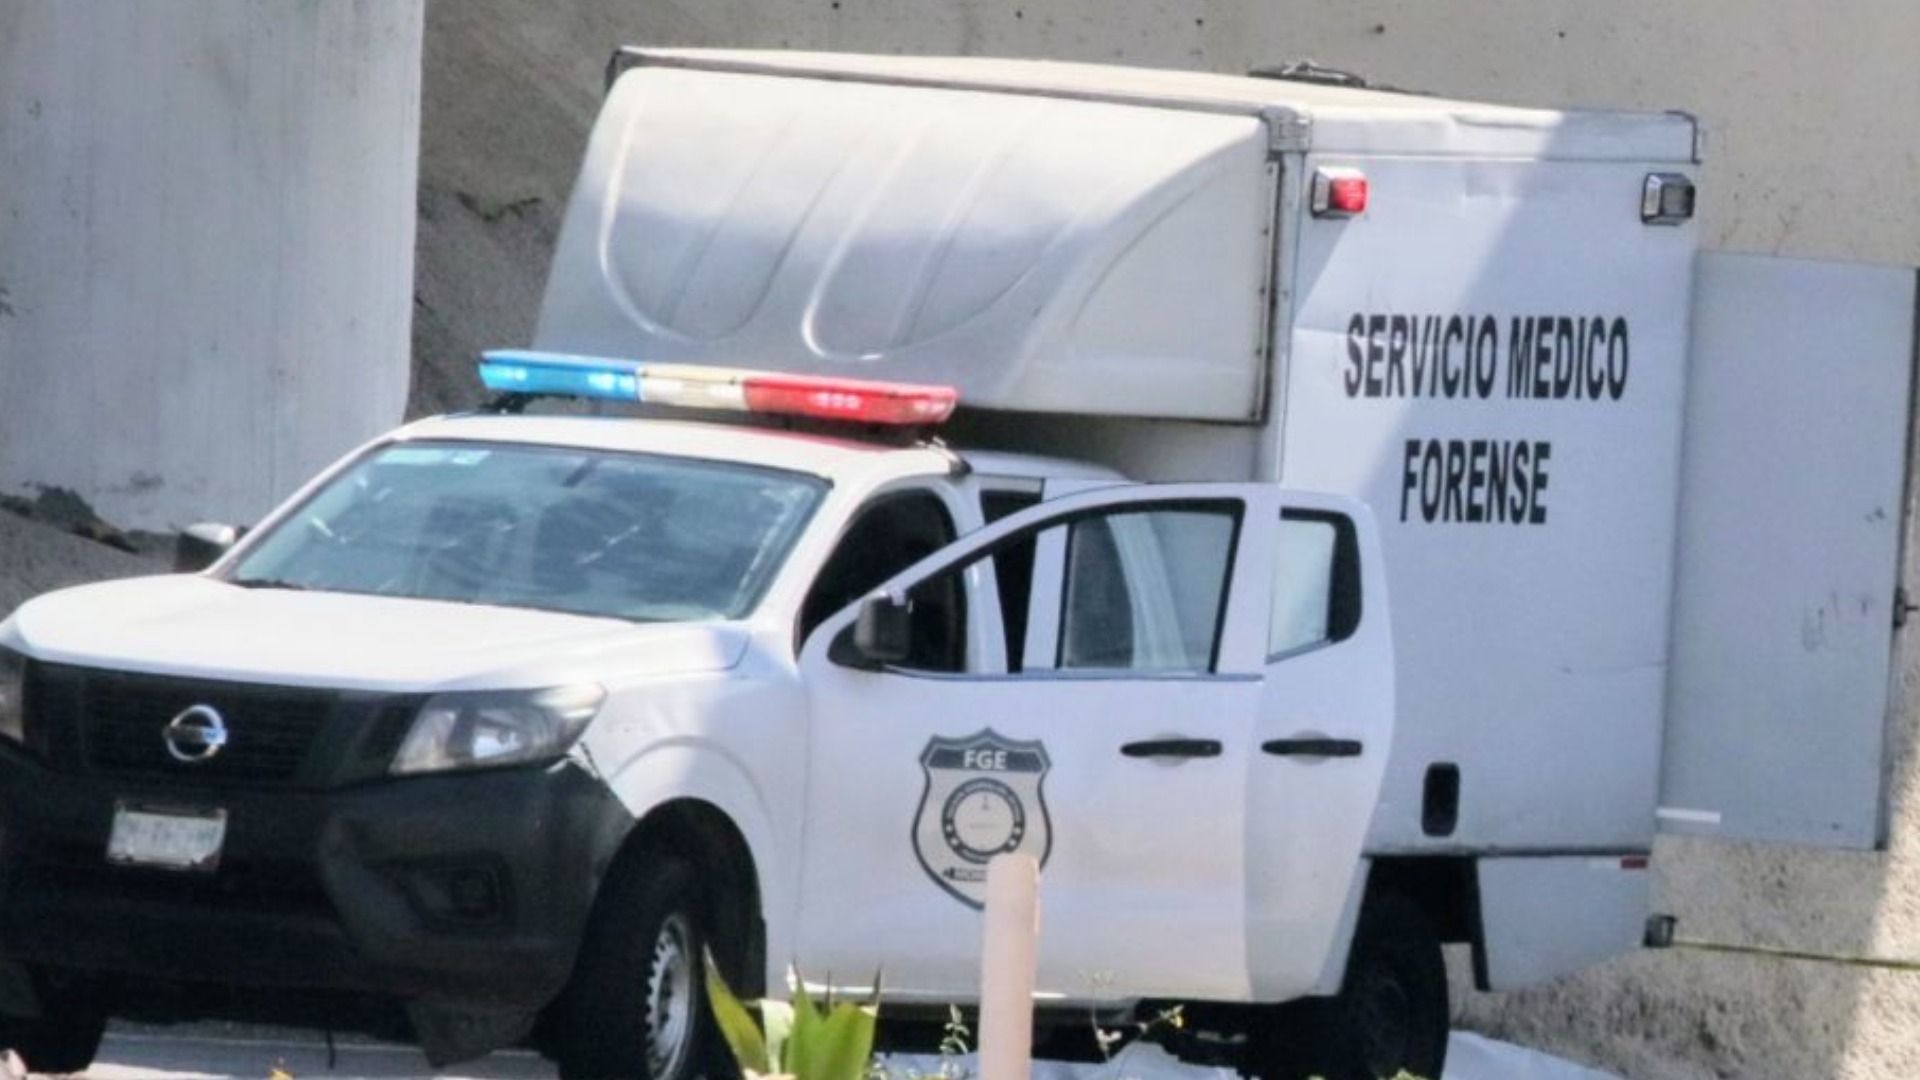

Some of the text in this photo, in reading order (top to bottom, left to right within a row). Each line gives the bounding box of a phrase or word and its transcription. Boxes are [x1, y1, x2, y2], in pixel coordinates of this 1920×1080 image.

[1345, 313, 1629, 400] SERVICIO MEDICO
[1400, 438, 1551, 525] FORENSE
[963, 750, 1008, 770] FGE
